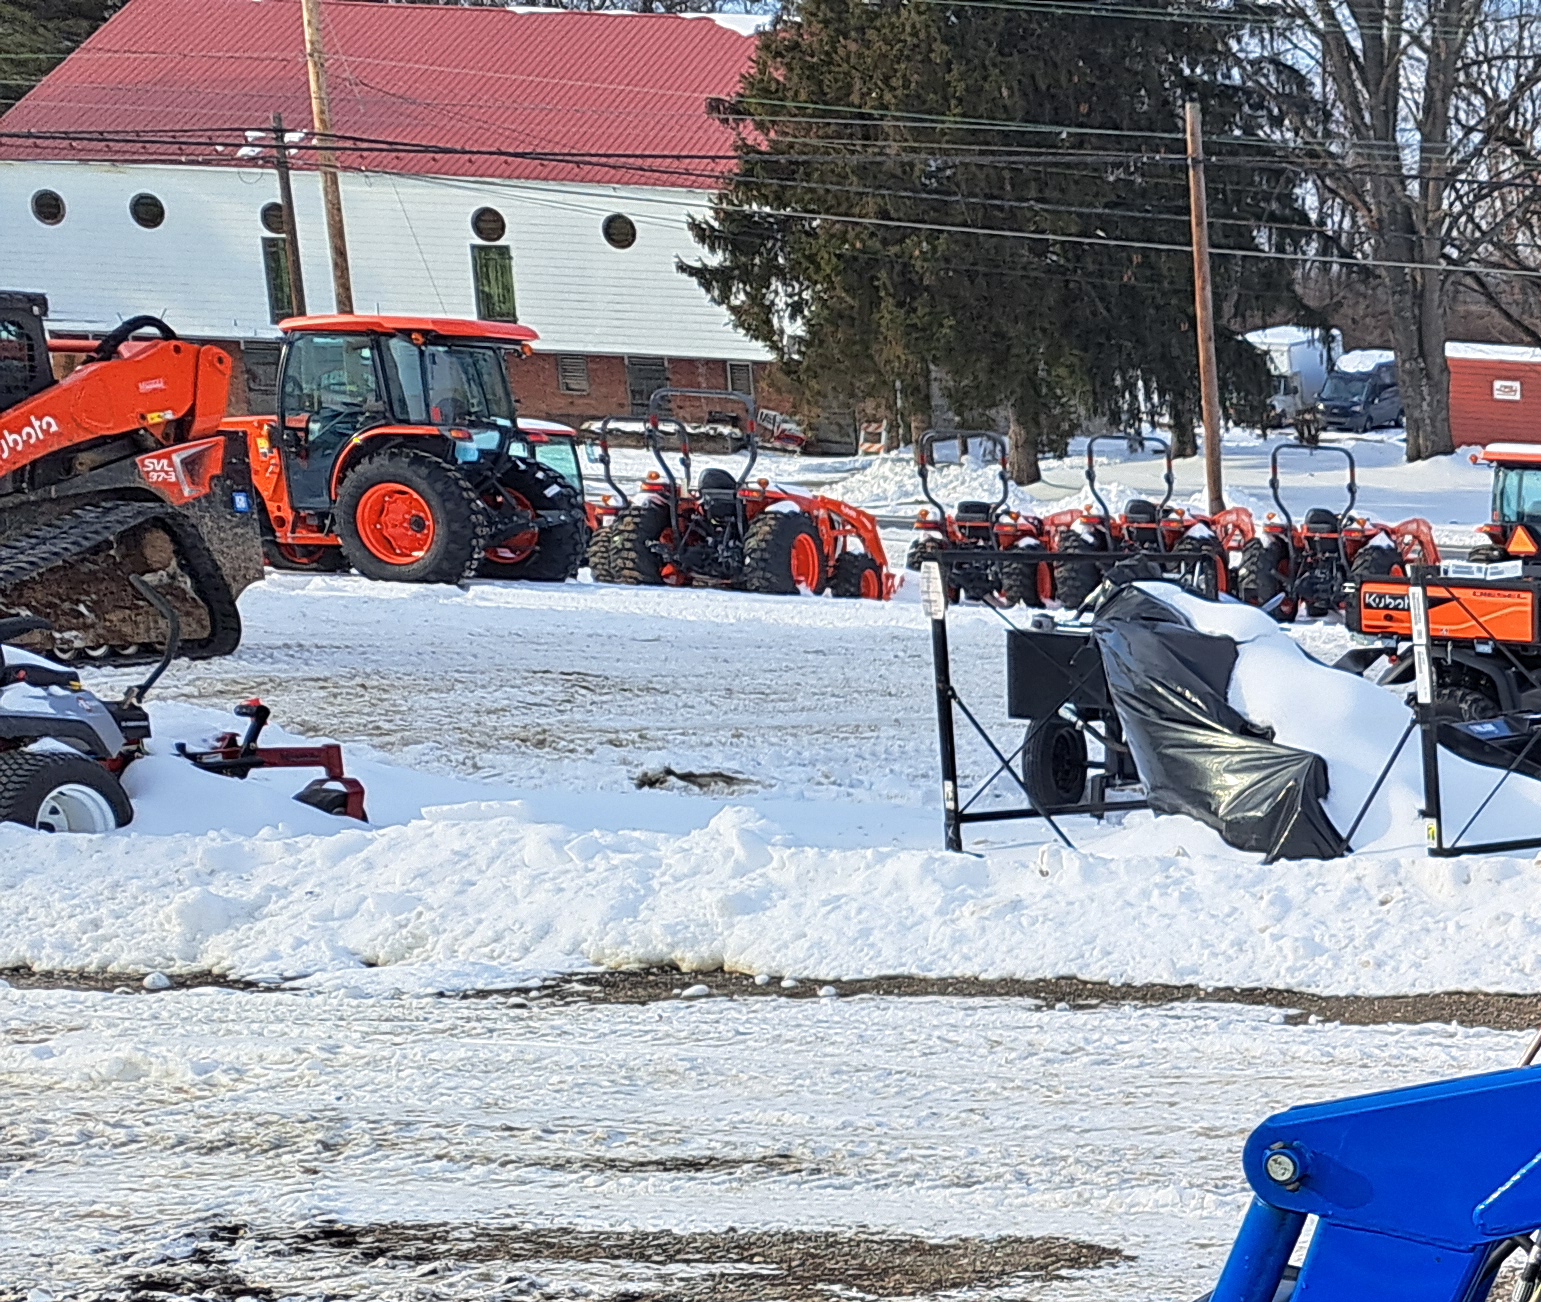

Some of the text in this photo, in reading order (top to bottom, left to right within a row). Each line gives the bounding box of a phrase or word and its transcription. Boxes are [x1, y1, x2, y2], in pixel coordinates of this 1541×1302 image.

[0, 415, 59, 459] bota
[143, 459, 174, 471] SVL
[1365, 593, 1411, 609] Kubot
